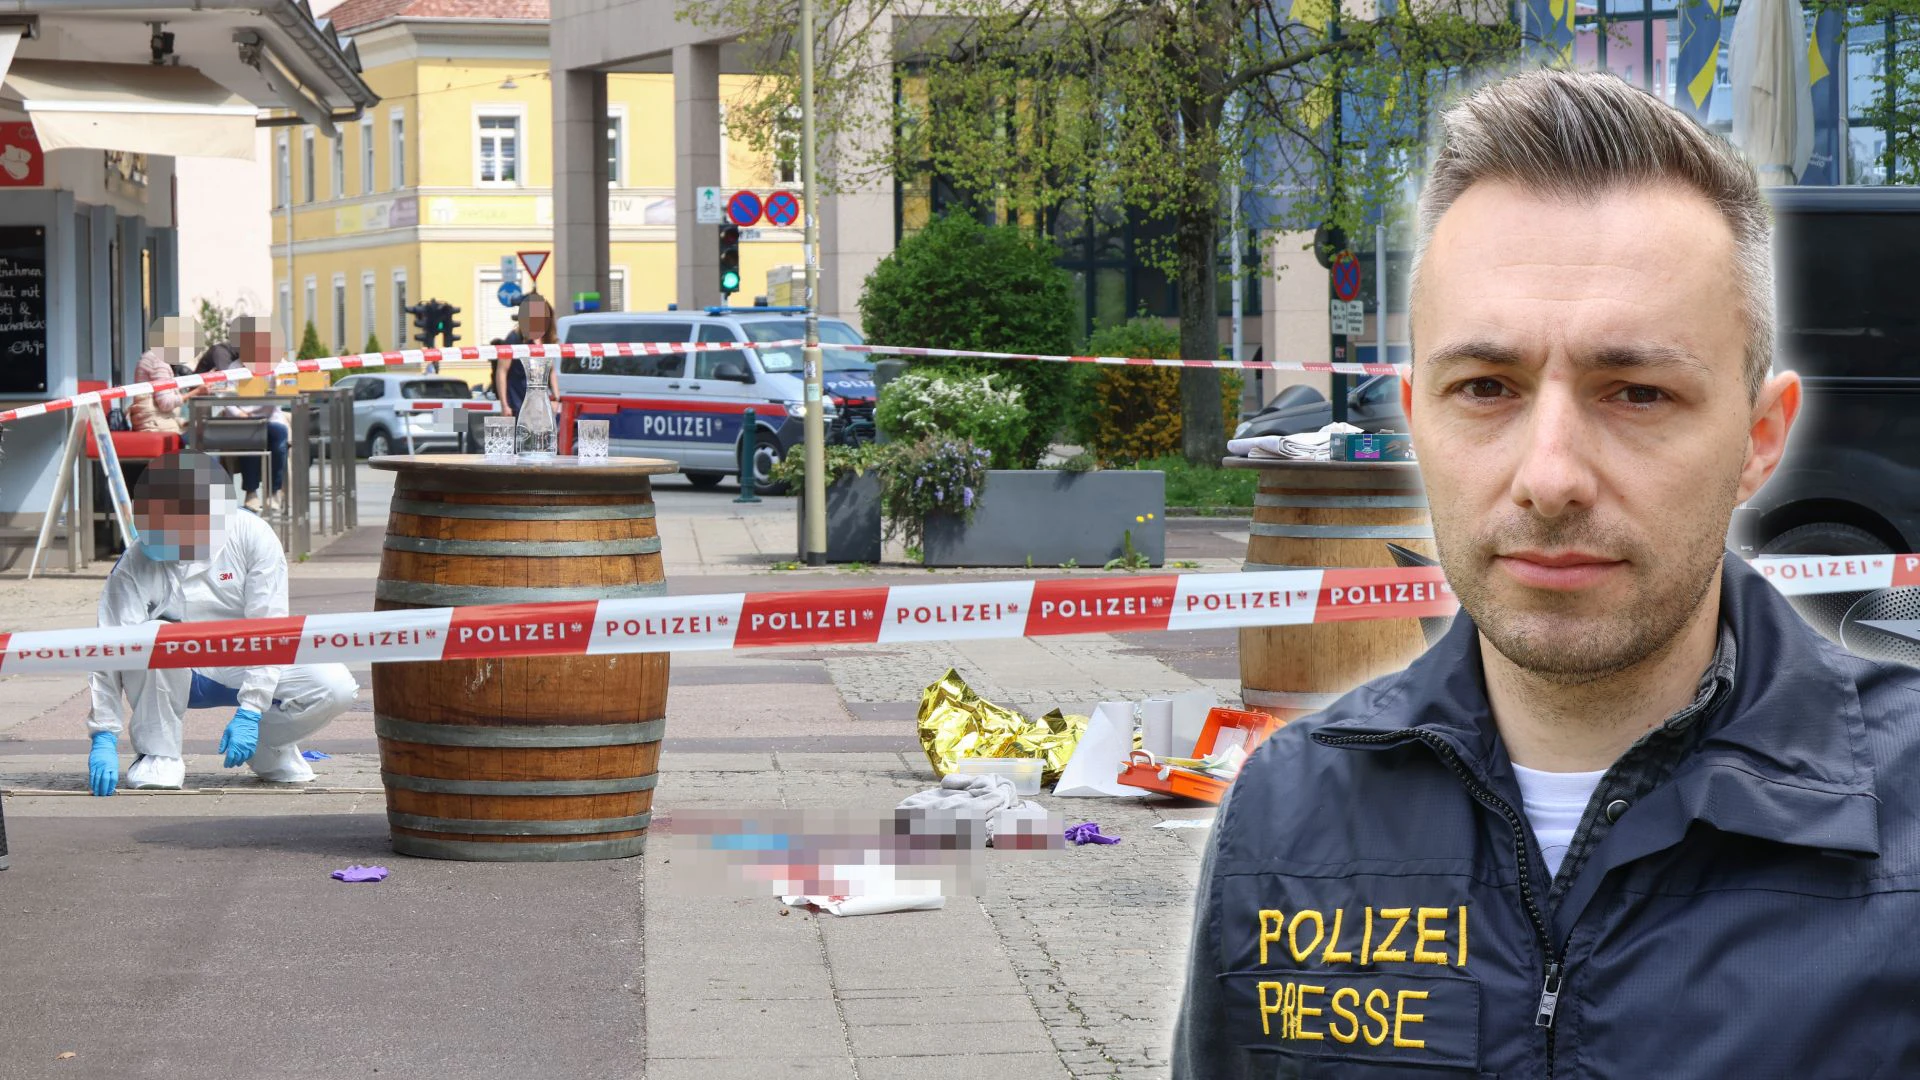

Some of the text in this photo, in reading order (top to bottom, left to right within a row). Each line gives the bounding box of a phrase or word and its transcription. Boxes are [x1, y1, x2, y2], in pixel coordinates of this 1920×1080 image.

[827, 380, 876, 389] POLIZ
[643, 415, 712, 437] POLIZEI
[1763, 560, 1868, 580] POLIZEI
[19, 581, 1436, 660] POLIZEI POLIZEI POLIZEI POLIZEI POLIZEI POLIZEI POLIZEI POLIZEI POLIZEI POLIZEI
[1258, 905, 1468, 967] POLIZEI
[1257, 981, 1429, 1048] PRESSE
